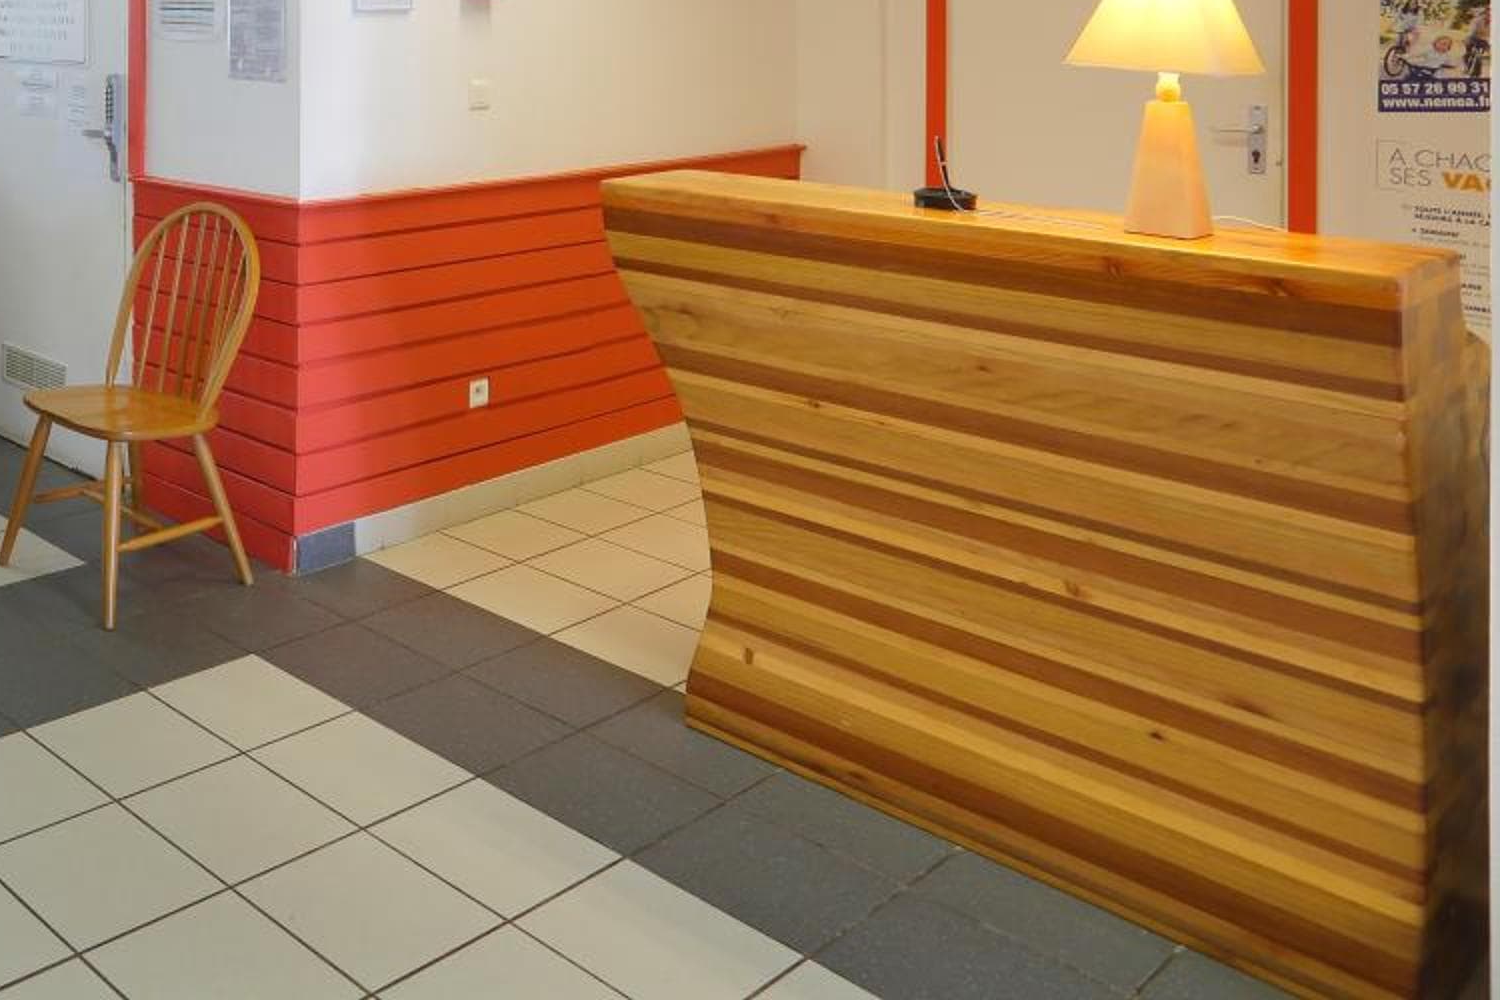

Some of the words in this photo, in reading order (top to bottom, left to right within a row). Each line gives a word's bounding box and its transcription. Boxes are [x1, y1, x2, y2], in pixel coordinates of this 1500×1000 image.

[1381, 83, 1399, 95] 05
[1389, 166, 1432, 187] SES
[1443, 170, 1491, 193] VA
